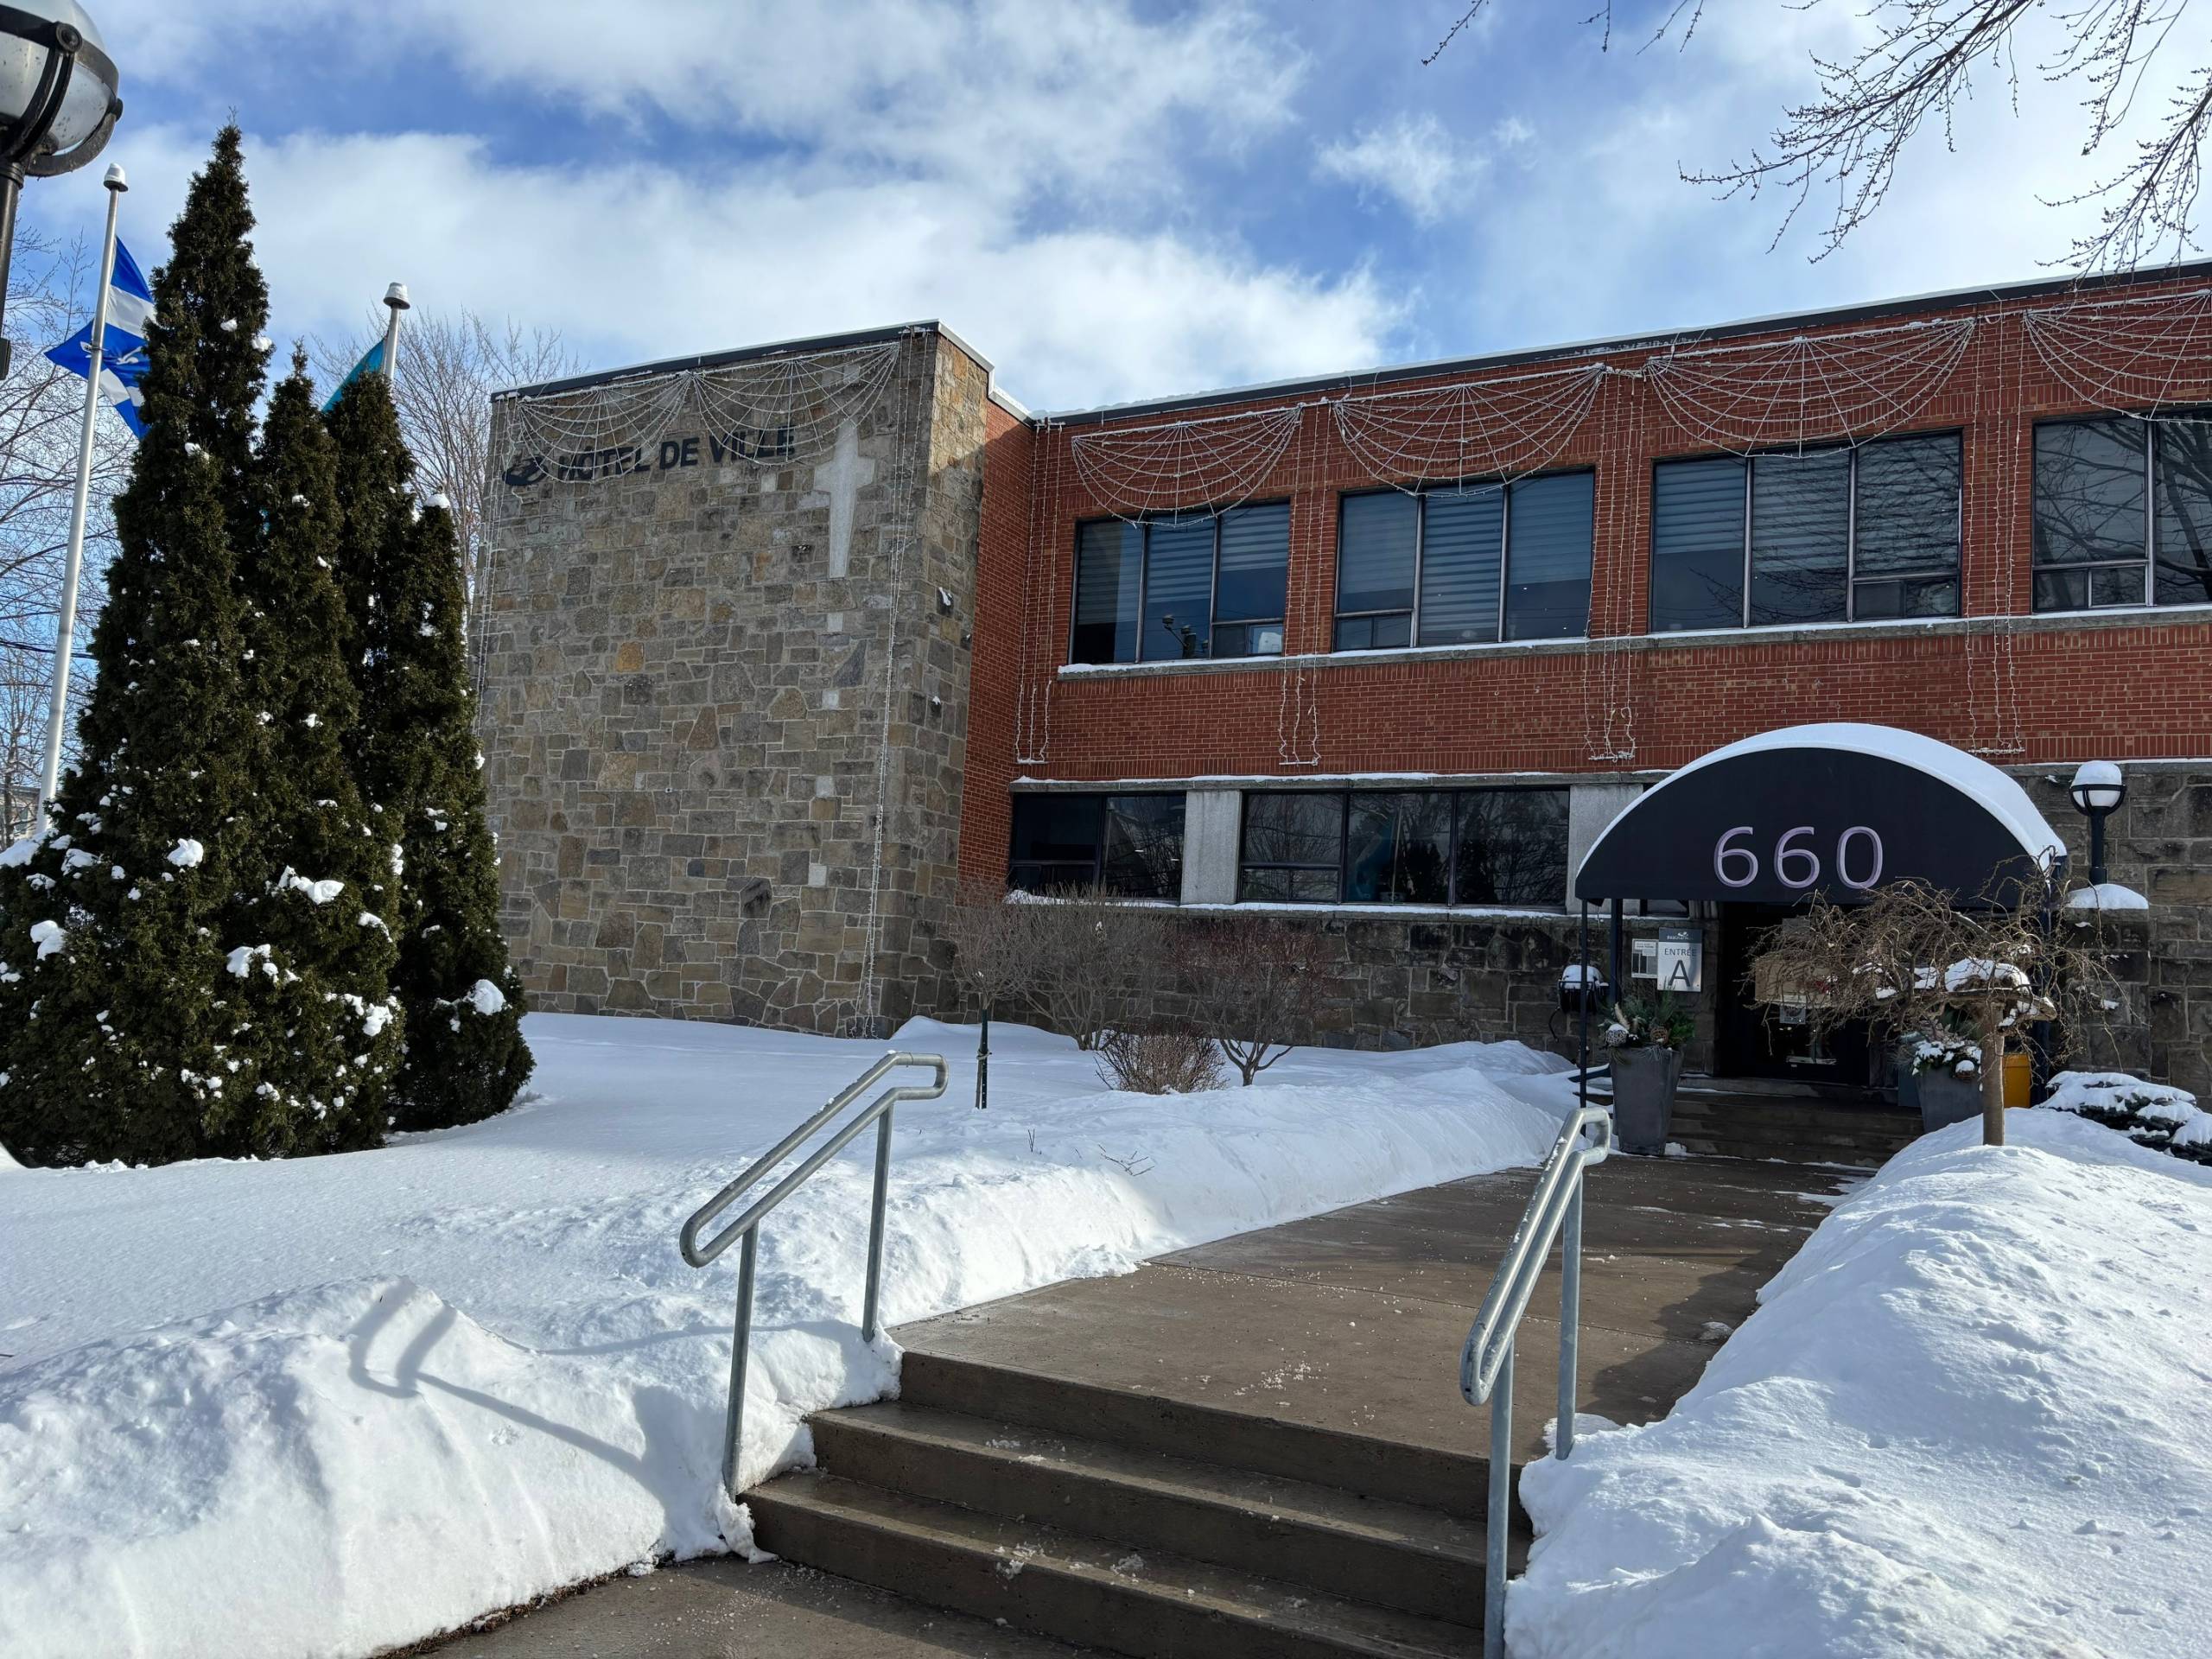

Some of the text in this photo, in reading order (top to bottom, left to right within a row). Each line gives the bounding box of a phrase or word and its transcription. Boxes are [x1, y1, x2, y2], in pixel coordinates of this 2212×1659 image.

[557, 424, 796, 480] HÔTEL DE VILLE
[1713, 826, 1883, 888] 660
[1664, 946, 1698, 957] ENTRÉE
[1668, 959, 1691, 987] A
